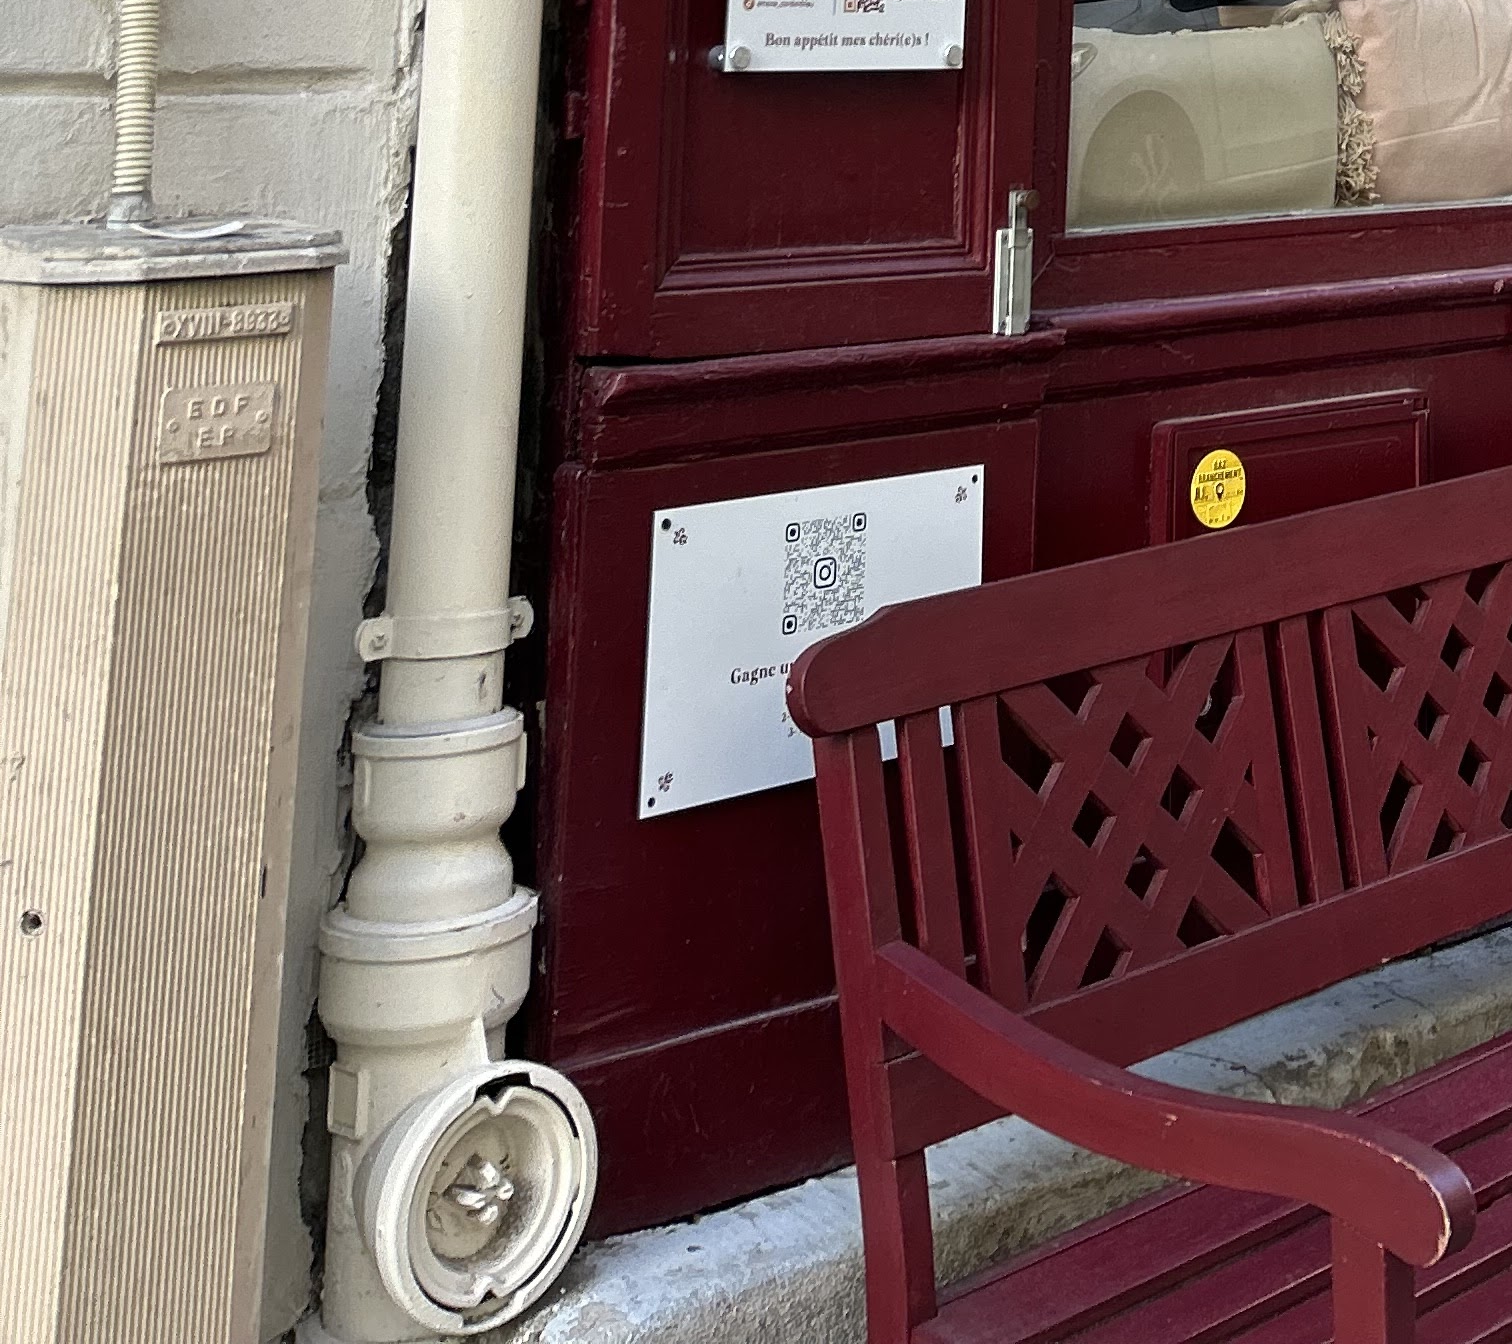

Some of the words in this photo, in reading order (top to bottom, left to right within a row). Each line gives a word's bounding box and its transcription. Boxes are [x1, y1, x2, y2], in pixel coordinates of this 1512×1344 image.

[765, 32, 791, 47] Bon
[794, 32, 838, 50] appétit
[840, 36, 866, 47] mes
[868, 32, 922, 48] chéri(e)s
[730, 665, 776, 686] Gagne
